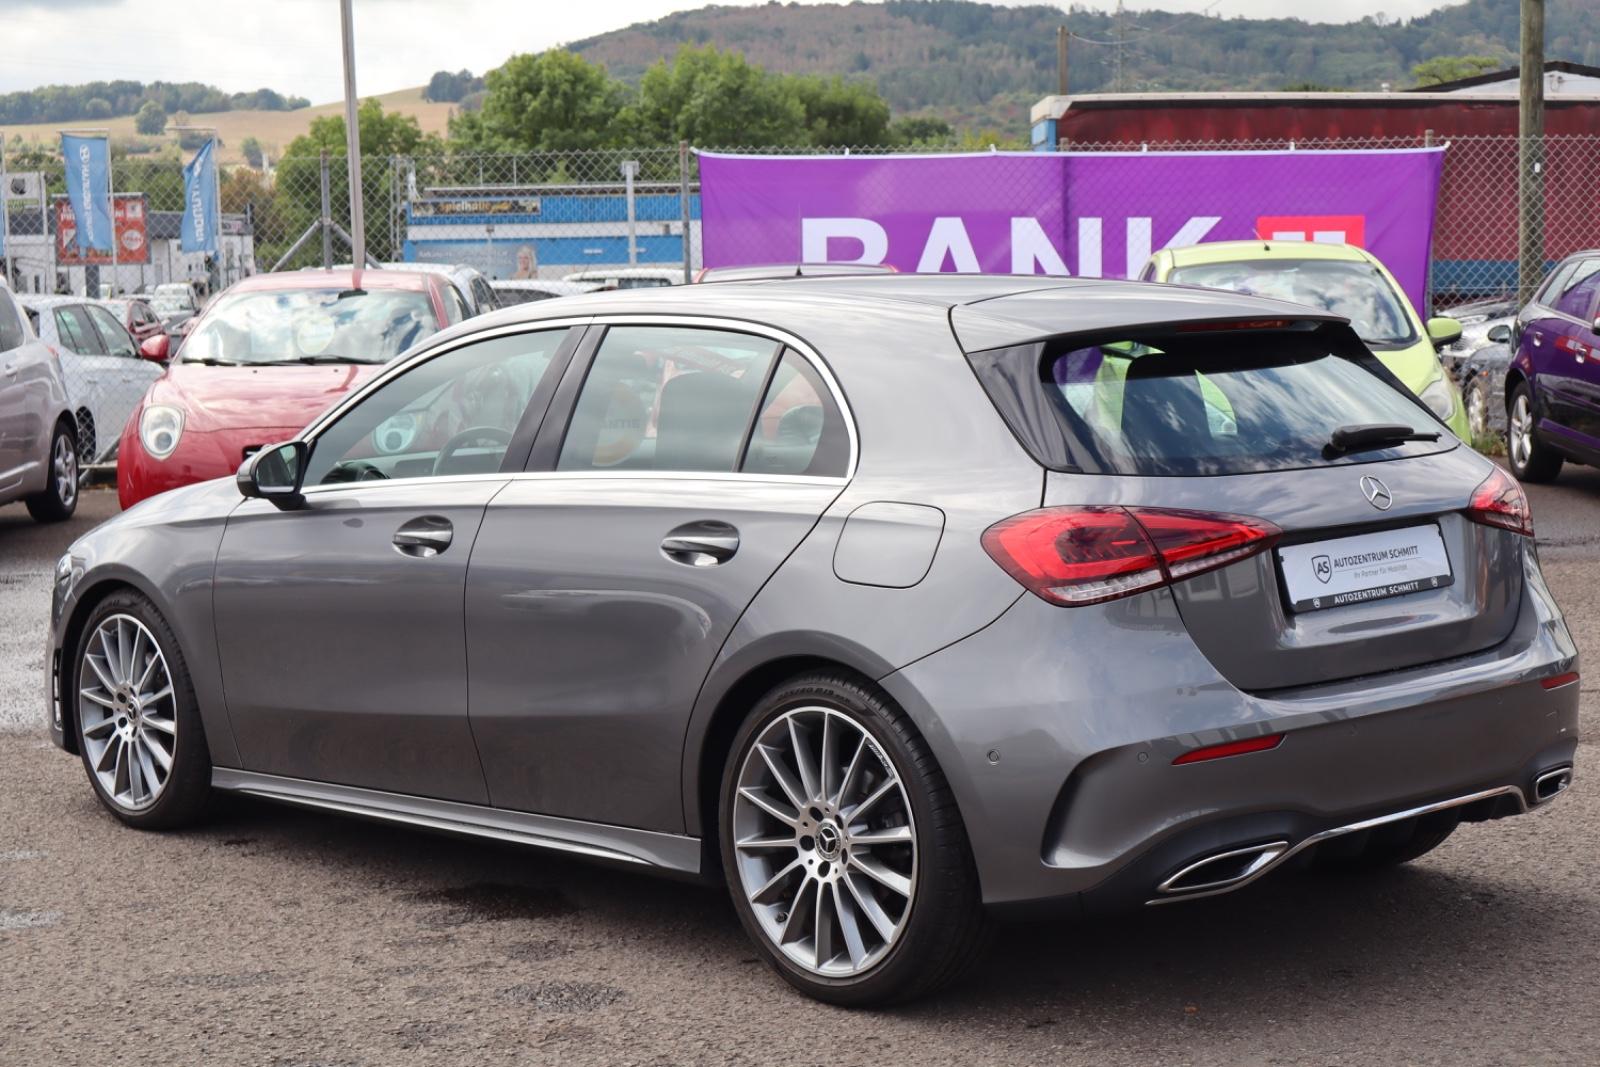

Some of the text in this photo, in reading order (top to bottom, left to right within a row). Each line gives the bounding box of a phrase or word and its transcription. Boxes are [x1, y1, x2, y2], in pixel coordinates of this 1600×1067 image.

[1317, 561, 1330, 575] AS
[1334, 545, 1418, 568] AUTOZENTRUM SCHMITT
[1334, 587, 1388, 604] AUTOZENTRUM
[1389, 581, 1419, 594] SCHMITT
